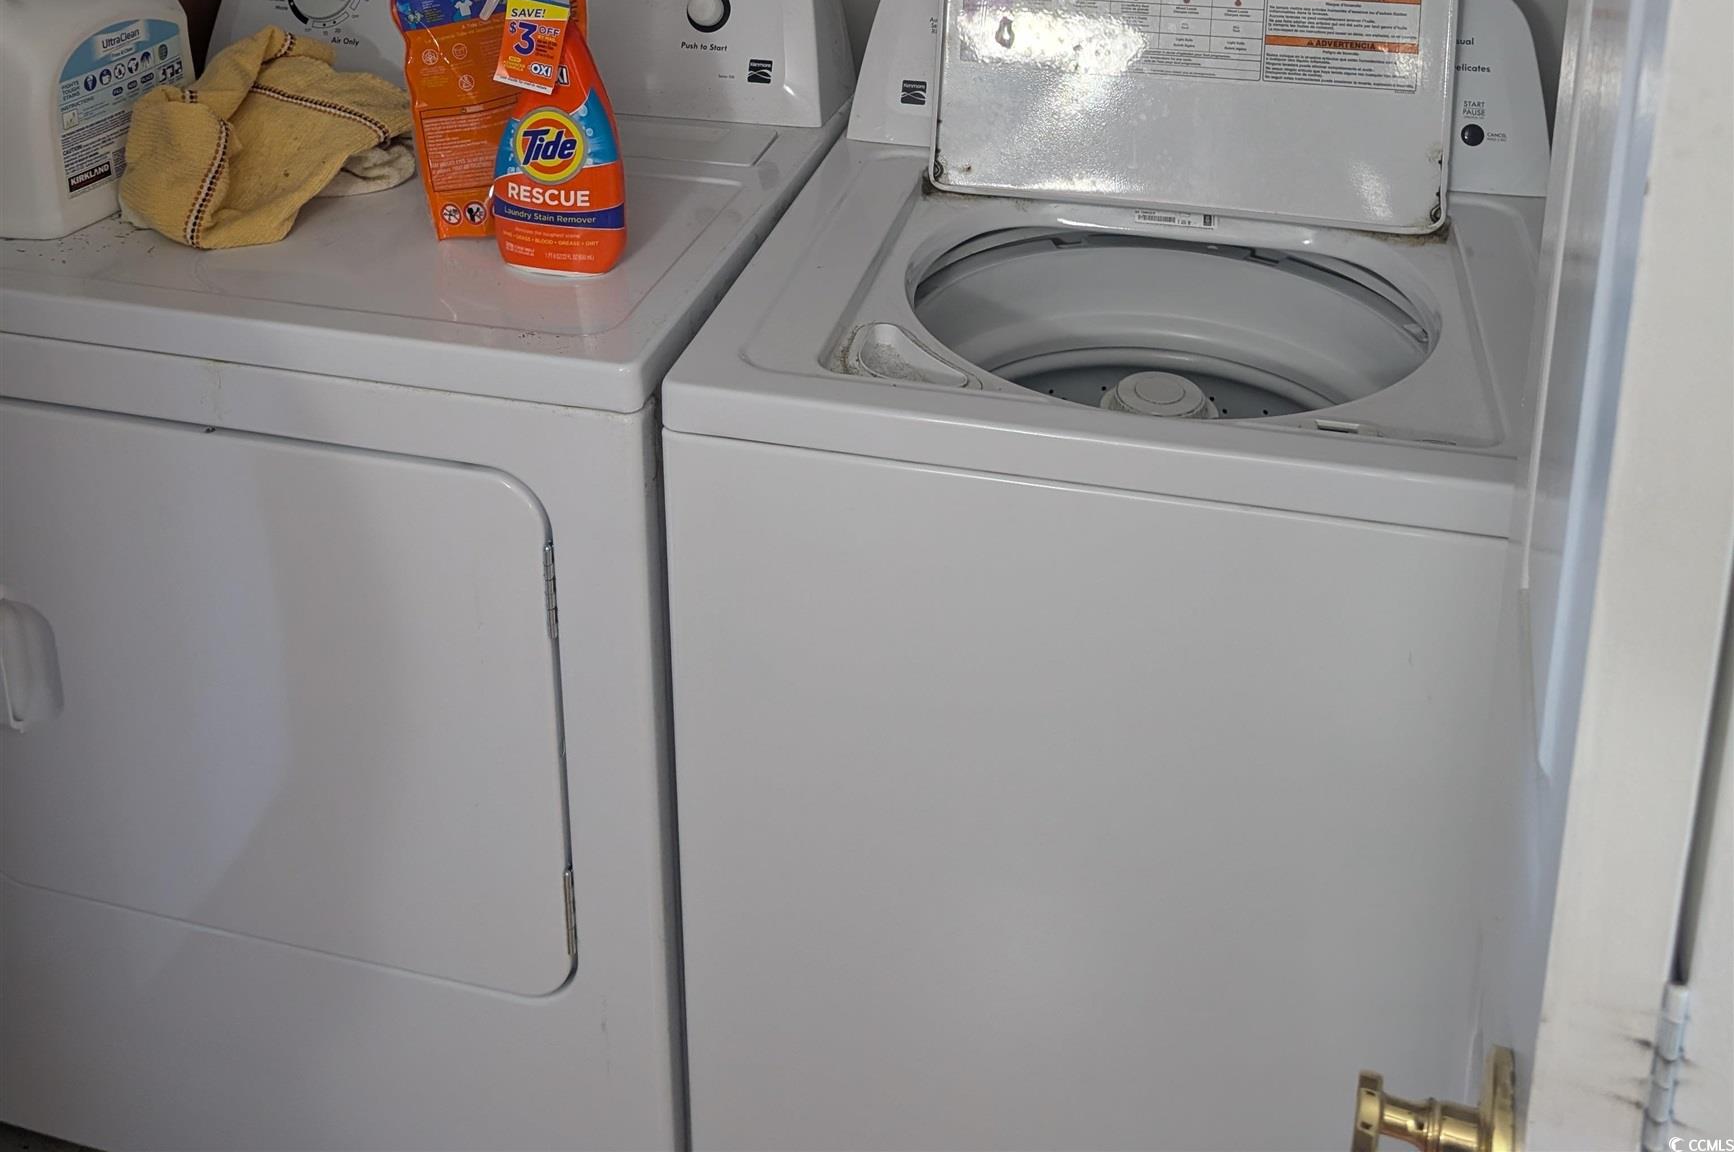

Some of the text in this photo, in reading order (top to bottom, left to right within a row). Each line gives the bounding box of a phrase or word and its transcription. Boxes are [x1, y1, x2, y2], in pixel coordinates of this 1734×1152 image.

[511, 8, 546, 18] SAVE!
[539, 26, 560, 36] OFF
[102, 28, 140, 49] UltraClean
[343, 38, 360, 46] Only
[681, 42, 698, 50] Push
[1315, 40, 1376, 50] ADVERTENCIA
[530, 63, 552, 77] OXI
[1455, 64, 1491, 72] elicates
[522, 128, 576, 166] Tide
[70, 164, 109, 186] KIRKLAND
[508, 182, 590, 207] RESCUE
[504, 207, 596, 224] Laundry Stain Remover
